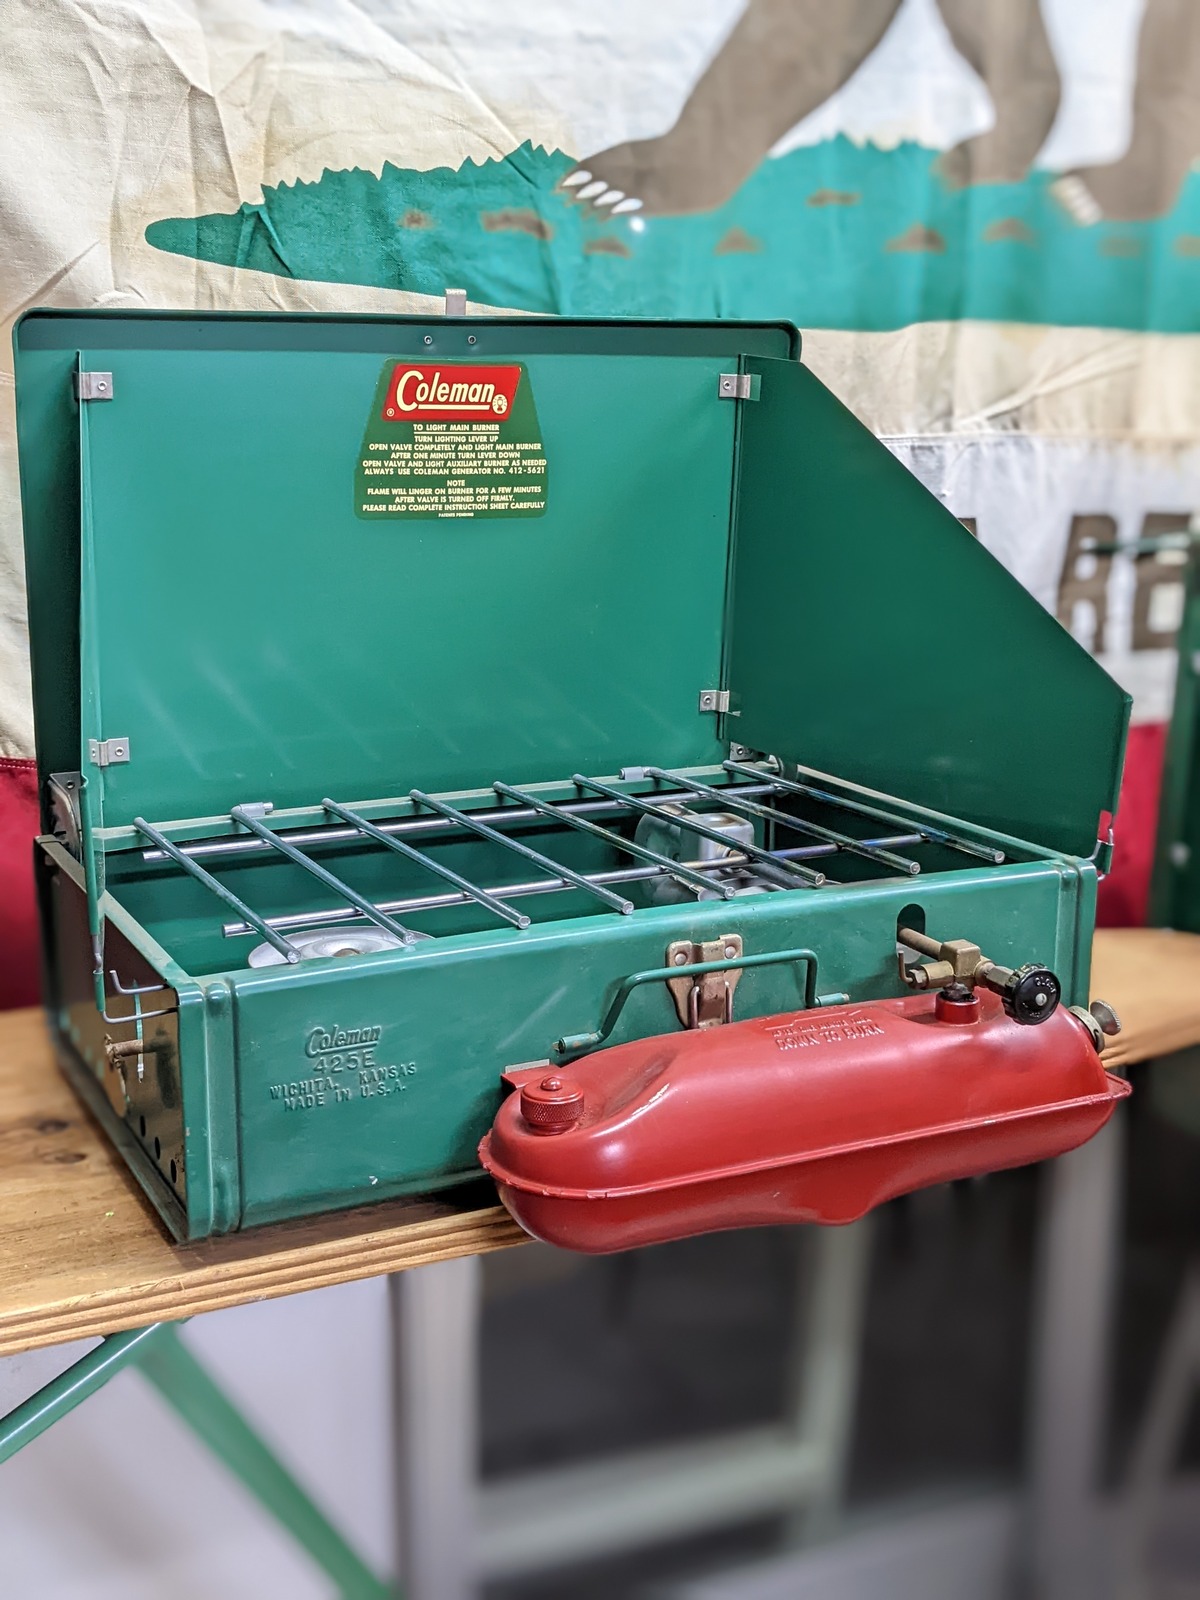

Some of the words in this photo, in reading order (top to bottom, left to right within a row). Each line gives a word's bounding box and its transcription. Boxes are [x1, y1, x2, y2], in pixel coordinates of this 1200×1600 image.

[396, 370, 495, 412] Coleman
[305, 1024, 382, 1058] Coleman
[313, 1048, 376, 1074] 425E
[359, 1062, 417, 1085] KANSAS
[284, 1092, 325, 1112] MADE
[336, 1088, 352, 1102] IN
